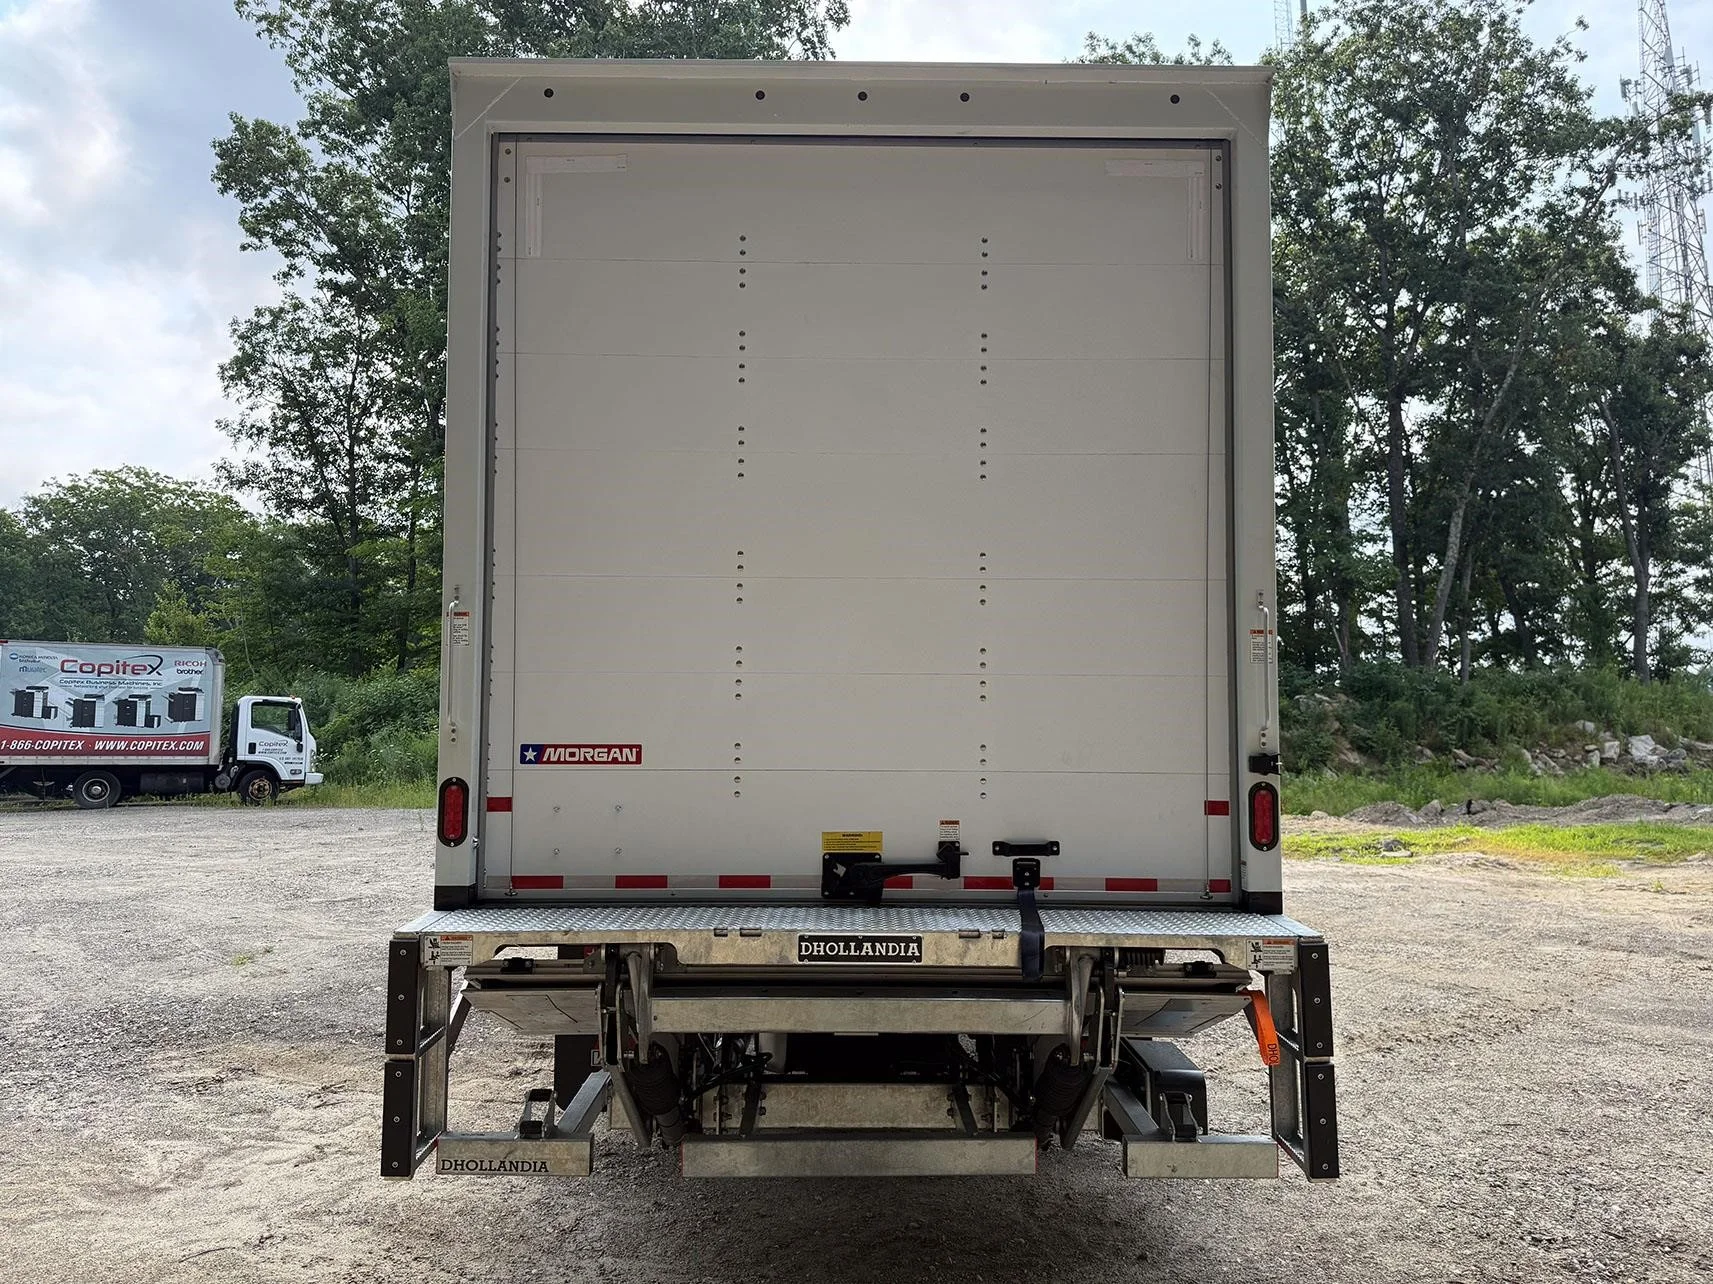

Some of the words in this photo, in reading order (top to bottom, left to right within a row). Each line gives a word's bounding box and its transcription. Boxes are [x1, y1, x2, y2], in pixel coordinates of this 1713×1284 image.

[60, 655, 163, 677] Copitex
[1, 740, 84, 750] 1-866-COPITEX
[95, 740, 204, 751] WWW.COPITEX.COM
[542, 747, 637, 762] MORGAN
[800, 942, 920, 956] DHOLLANDIA
[441, 1159, 549, 1173] DHOLLANDIA
